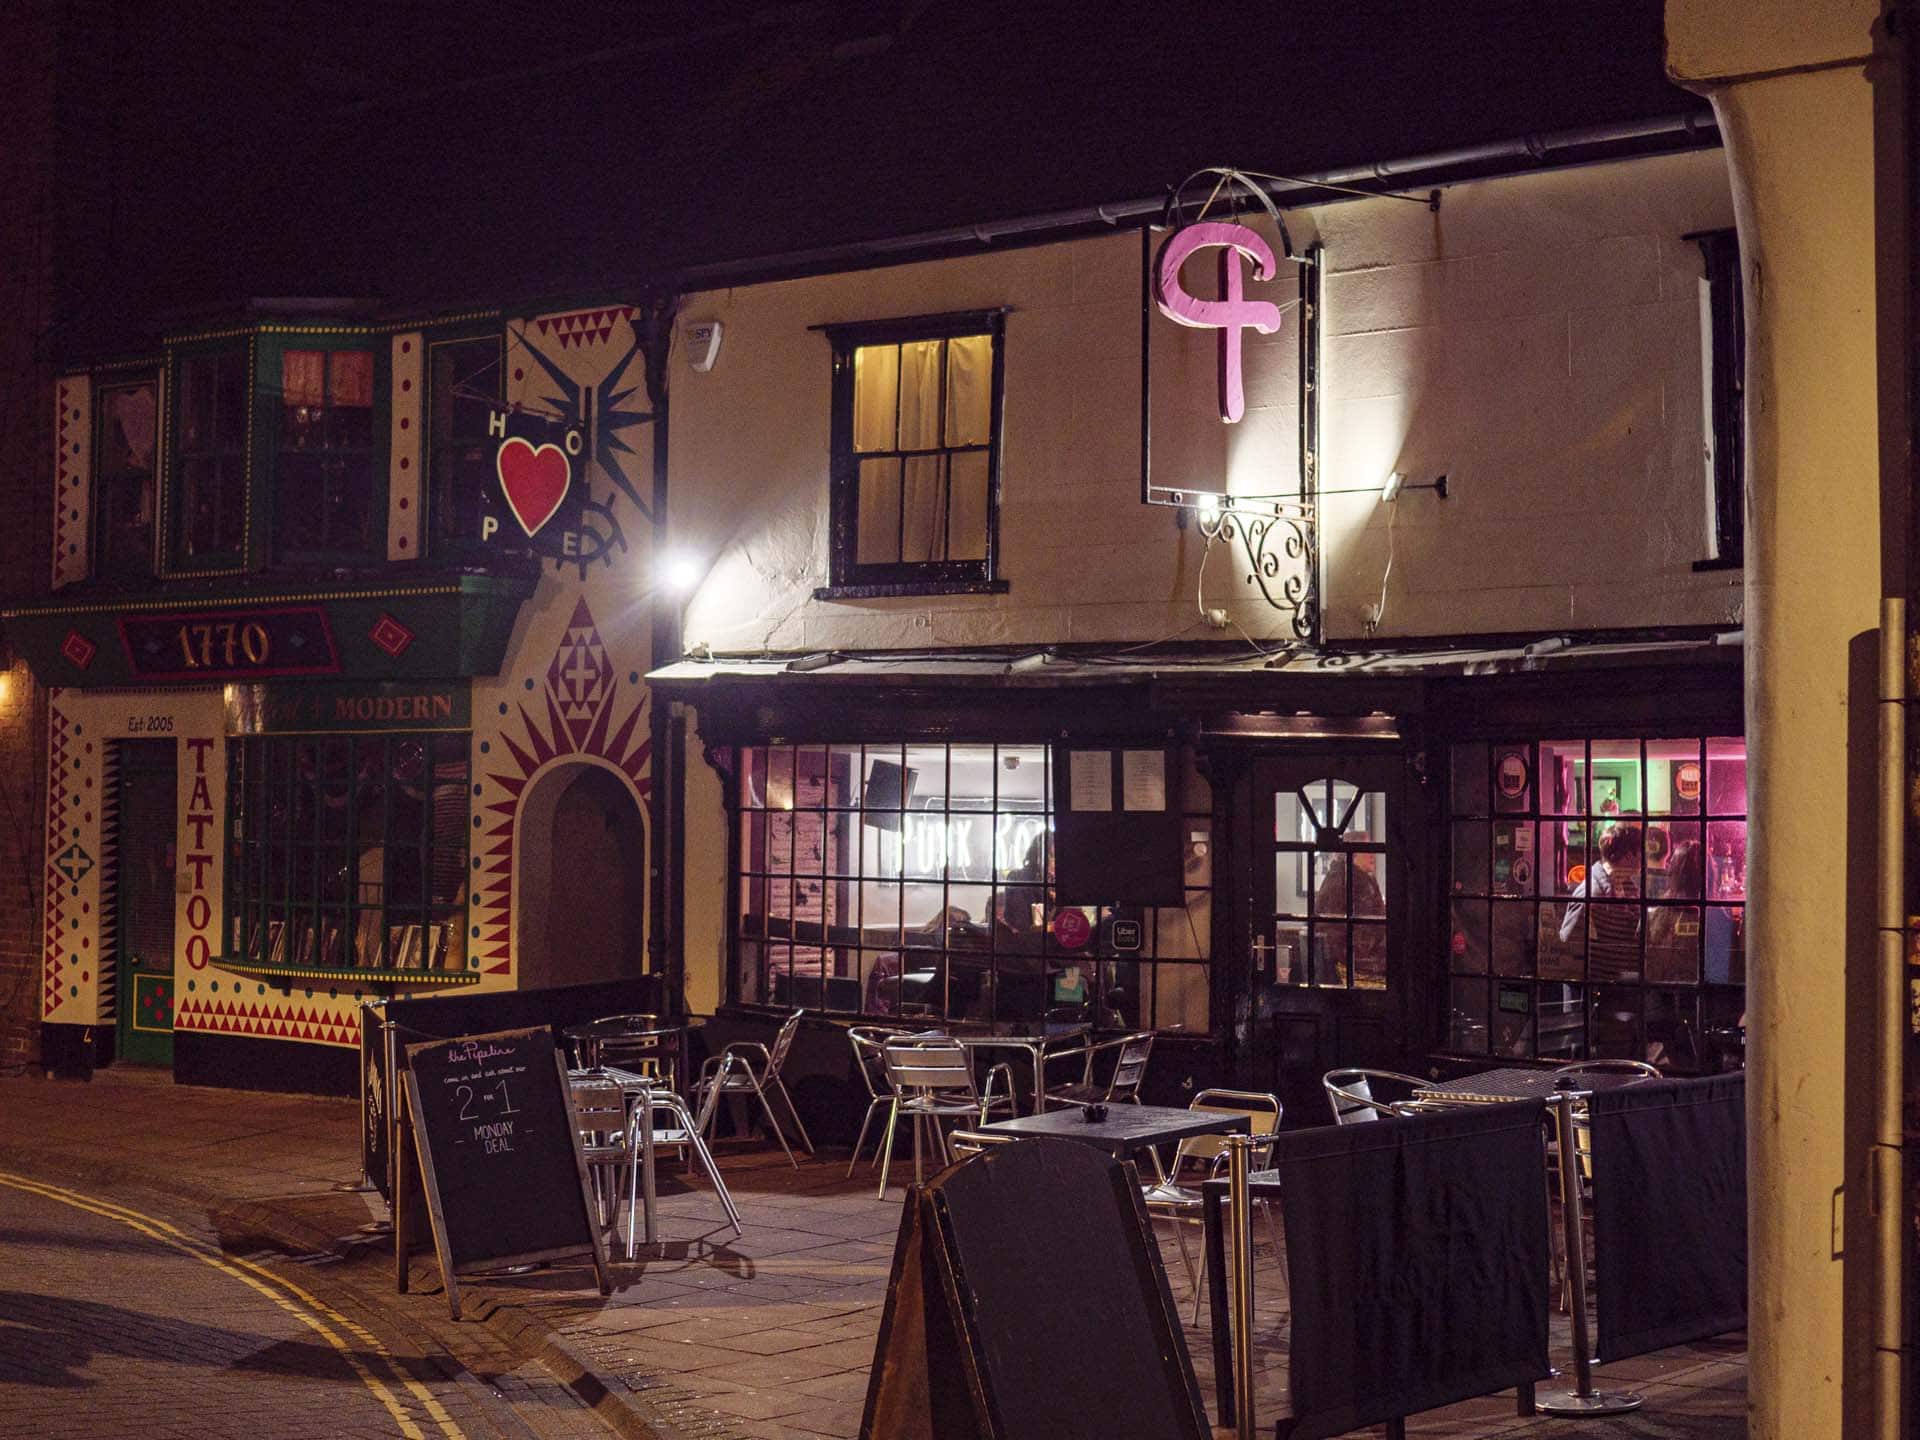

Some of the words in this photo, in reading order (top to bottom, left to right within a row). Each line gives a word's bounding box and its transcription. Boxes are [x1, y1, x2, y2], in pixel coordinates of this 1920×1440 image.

[178, 622, 271, 668] 1770
[147, 716, 173, 732] 2005
[334, 695, 453, 721] MODERN
[185, 737, 214, 971] TATTOO
[456, 1085, 480, 1121] 2
[495, 1079, 522, 1115] 1
[473, 1121, 514, 1141] MONDAY
